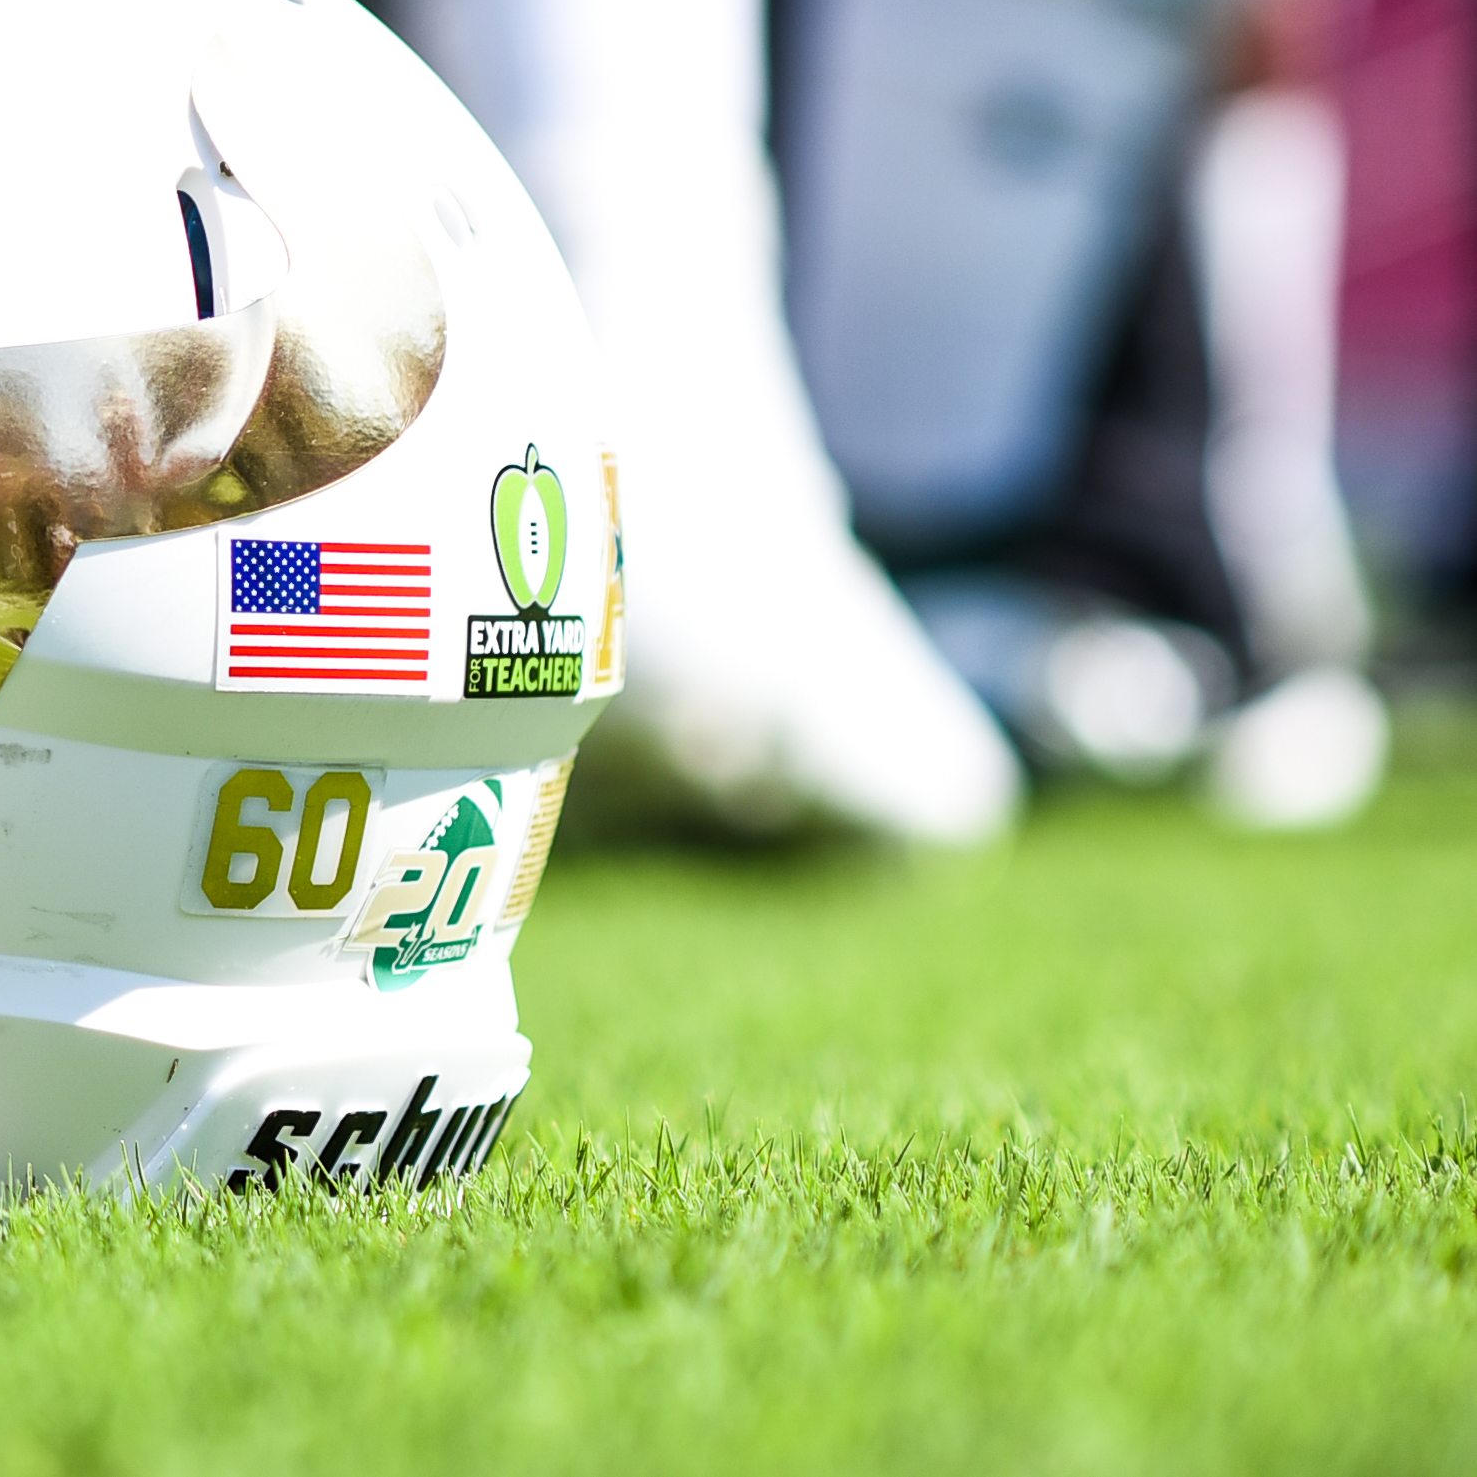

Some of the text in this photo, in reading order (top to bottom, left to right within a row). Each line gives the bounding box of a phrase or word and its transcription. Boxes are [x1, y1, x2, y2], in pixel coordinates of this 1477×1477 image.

[470, 620, 585, 654] EXTRA YARD
[468, 657, 582, 692] FOR TEACHERS
[201, 769, 371, 910] 60
[350, 849, 496, 945] 20
[423, 943, 469, 962] SEASONS
